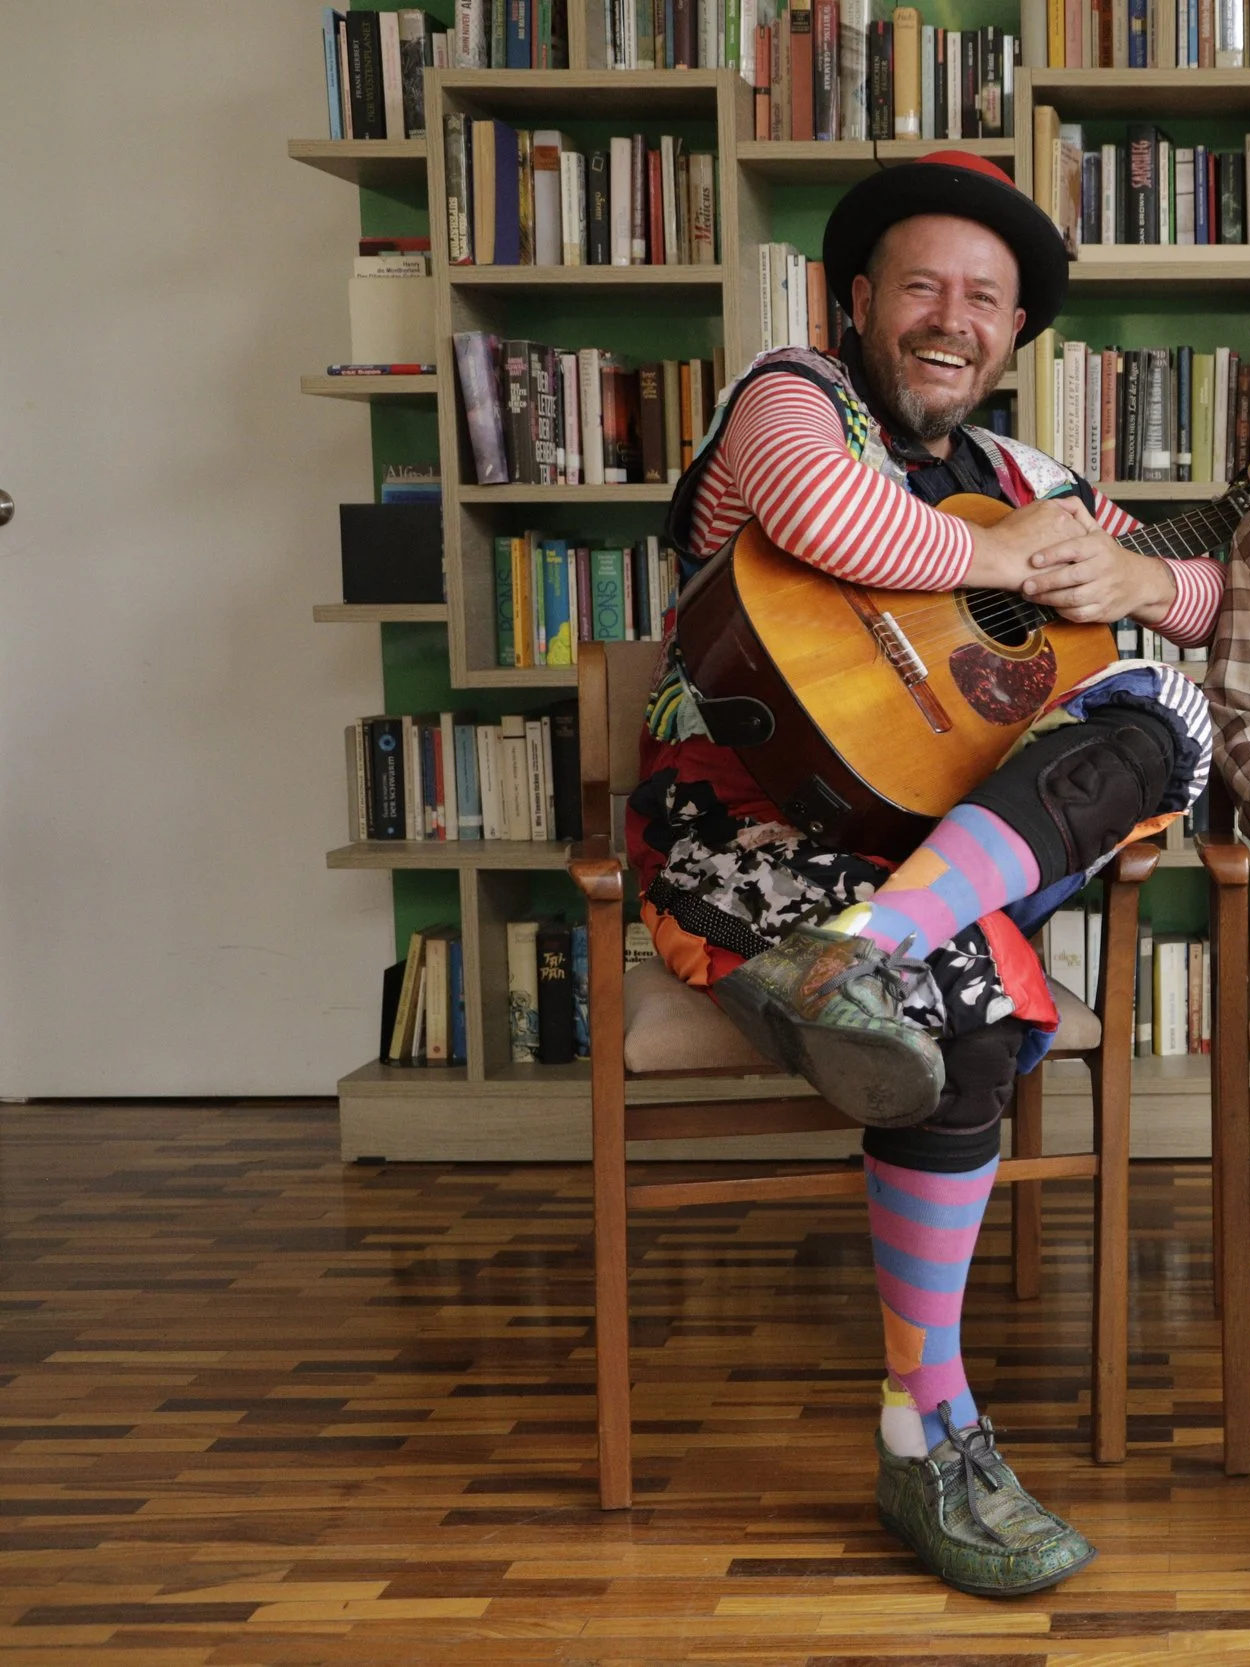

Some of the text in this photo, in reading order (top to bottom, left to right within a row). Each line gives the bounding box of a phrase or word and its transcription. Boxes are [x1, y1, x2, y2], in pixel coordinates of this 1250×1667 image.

[461, 13, 470, 56] JOHN NIVEN
[823, 5, 832, 41] WRITING
[353, 39, 363, 98] FRANK HERBERT
[362, 21, 376, 123] DER WÜSTENPLANET
[823, 51, 832, 90] GRAMMAR
[1131, 141, 1152, 188] SAKRILEG
[694, 187, 712, 245] Medicus
[510, 388, 527, 396] LETZTE
[537, 371, 549, 393] DER
[1130, 362, 1140, 384] Augen
[538, 393, 557, 417] LETZTE
[1129, 396, 1137, 413] Lust
[539, 417, 550, 440] DER
[497, 568, 514, 632] PONS
[596, 581, 618, 638] PONS
[387, 756, 396, 800] SCHWARM
